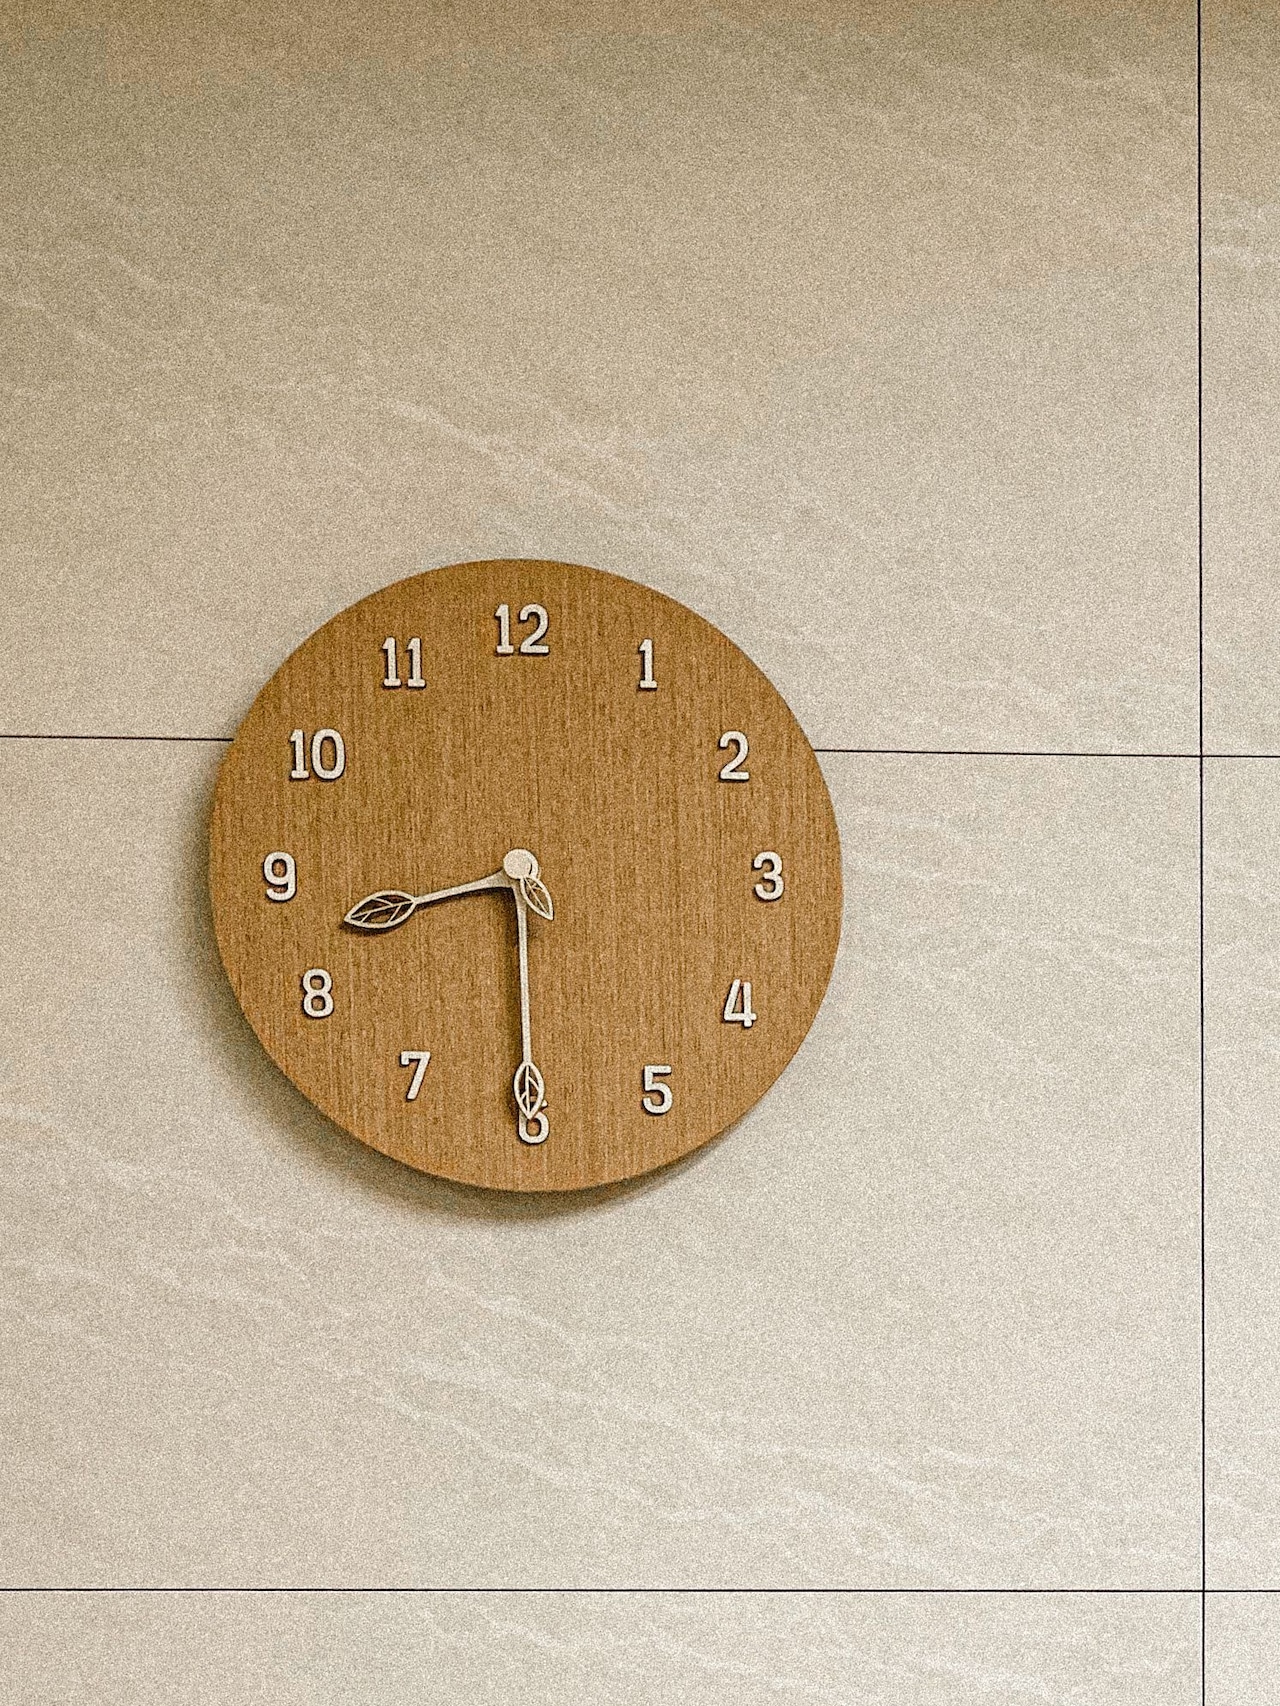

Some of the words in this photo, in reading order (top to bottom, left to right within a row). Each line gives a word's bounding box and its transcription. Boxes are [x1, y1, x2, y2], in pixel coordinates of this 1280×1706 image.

[495, 604, 550, 655] 12
[382, 637, 427, 689] 11
[637, 638, 658, 690] 1
[289, 728, 346, 781] 10
[718, 730, 751, 782] 2
[263, 851, 298, 902] 9
[752, 851, 785, 902] 3
[302, 968, 334, 1018] 8
[723, 978, 757, 1029] 4
[400, 1050, 431, 1101] 7
[642, 1064, 672, 1115] 5
